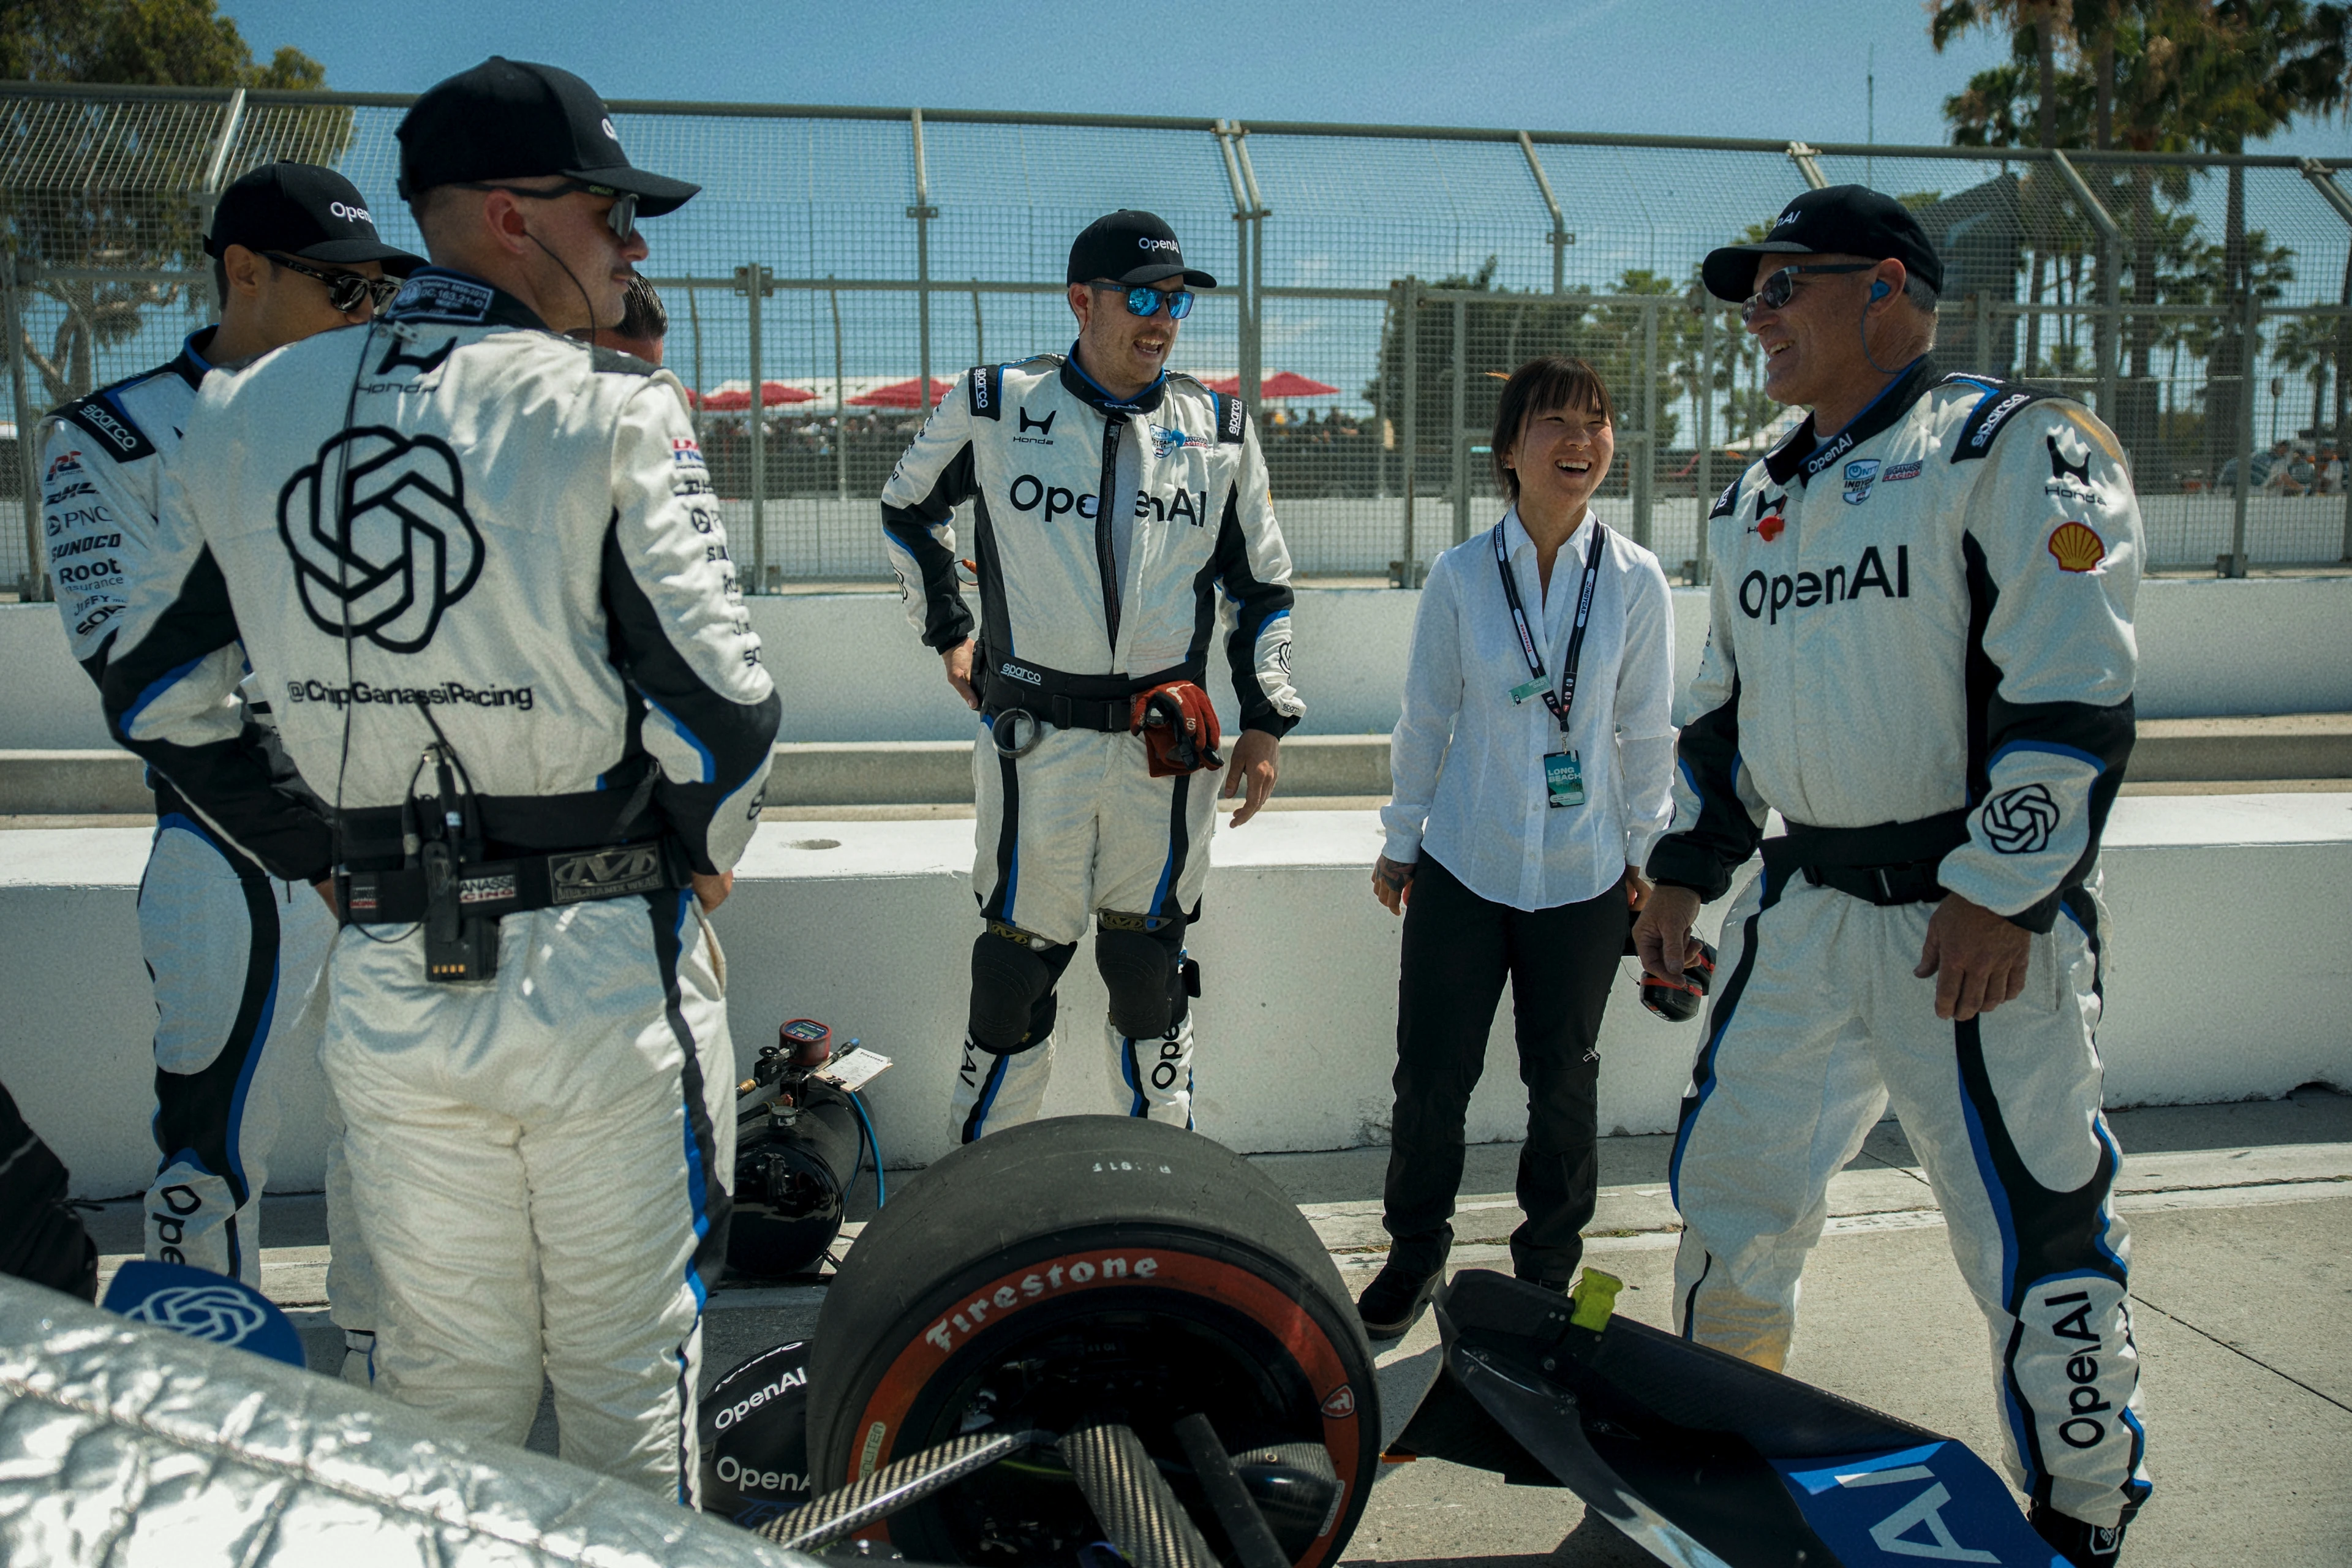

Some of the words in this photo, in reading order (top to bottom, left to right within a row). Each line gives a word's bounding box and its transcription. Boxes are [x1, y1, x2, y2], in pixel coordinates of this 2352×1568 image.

[1139, 237, 1180, 254] OpenAI
[974, 368, 989, 409] sparco
[78, 404, 138, 451] sparco
[1228, 399, 1242, 436] sparco
[1013, 435, 1054, 445] Honda
[1809, 433, 1853, 473] OpenAI
[2045, 486, 2107, 506] Honda
[62, 506, 113, 528] PNC
[1739, 545, 1909, 624] OpenAI
[1580, 587, 1591, 614] INDYCAR
[1520, 624, 1532, 654] Firestone
[1000, 663, 1041, 685] sparco
[1548, 767, 1575, 776] LONG
[1548, 772, 1581, 783] BEACH
[925, 1257, 1159, 1352] Firestone
[715, 1366, 808, 1429] OpenAI
